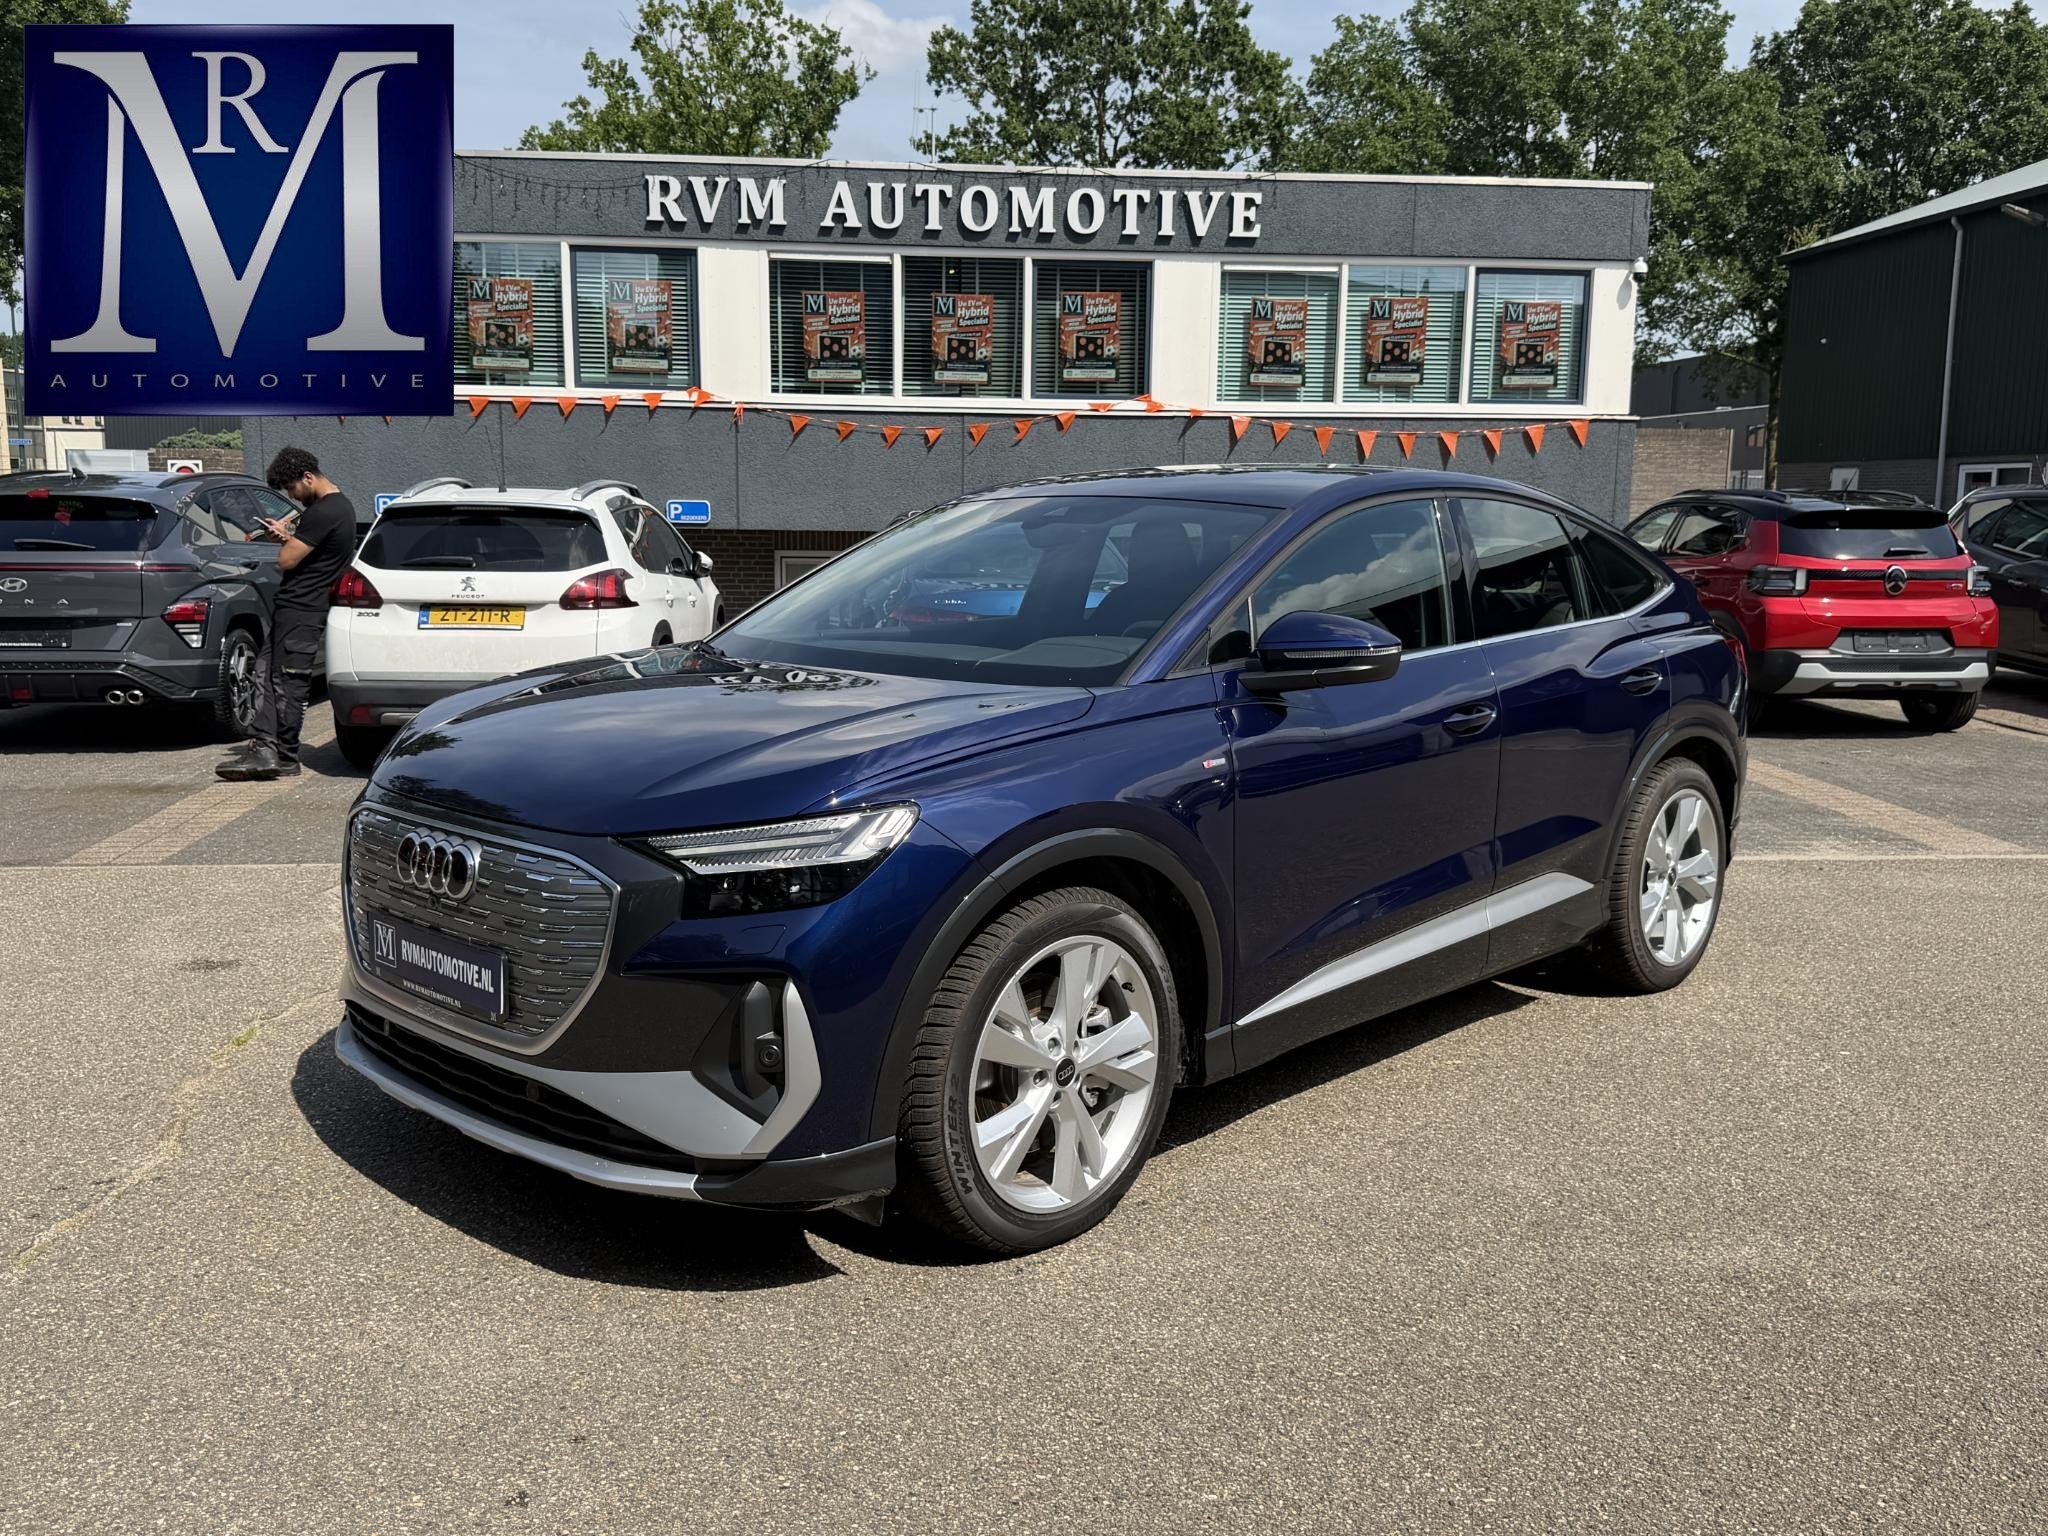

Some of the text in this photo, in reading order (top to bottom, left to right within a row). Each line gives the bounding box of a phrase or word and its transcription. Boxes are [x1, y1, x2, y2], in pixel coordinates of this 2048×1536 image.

[645, 174, 1263, 238] RVM AUTOMOTIVE
[495, 291, 528, 304] Hybrid
[635, 292, 668, 305] Hybrid
[497, 303, 528, 311] Specialist
[637, 304, 667, 312] Specialist
[829, 303, 860, 316] Hybrid
[958, 306, 989, 319] Hybrid
[1086, 303, 1117, 317] Hybrid
[830, 315, 860, 324] Specialist
[959, 318, 988, 326] Specialist
[1087, 315, 1116, 324] Specialist
[1275, 311, 1304, 324] Hybrid
[1393, 309, 1424, 322] Hybrid
[1527, 312, 1557, 324] Hybrid
[1276, 322, 1302, 330] Specialist
[1394, 320, 1423, 329] Specialist
[1528, 323, 1557, 332] Specialist
[379, 498, 391, 513] P
[670, 503, 683, 519] P
[440, 607, 510, 622] ZT-211-R
[401, 939, 495, 994] RVMAUTOMOTIVE.NL
[947, 1095, 974, 1195] WINTER
